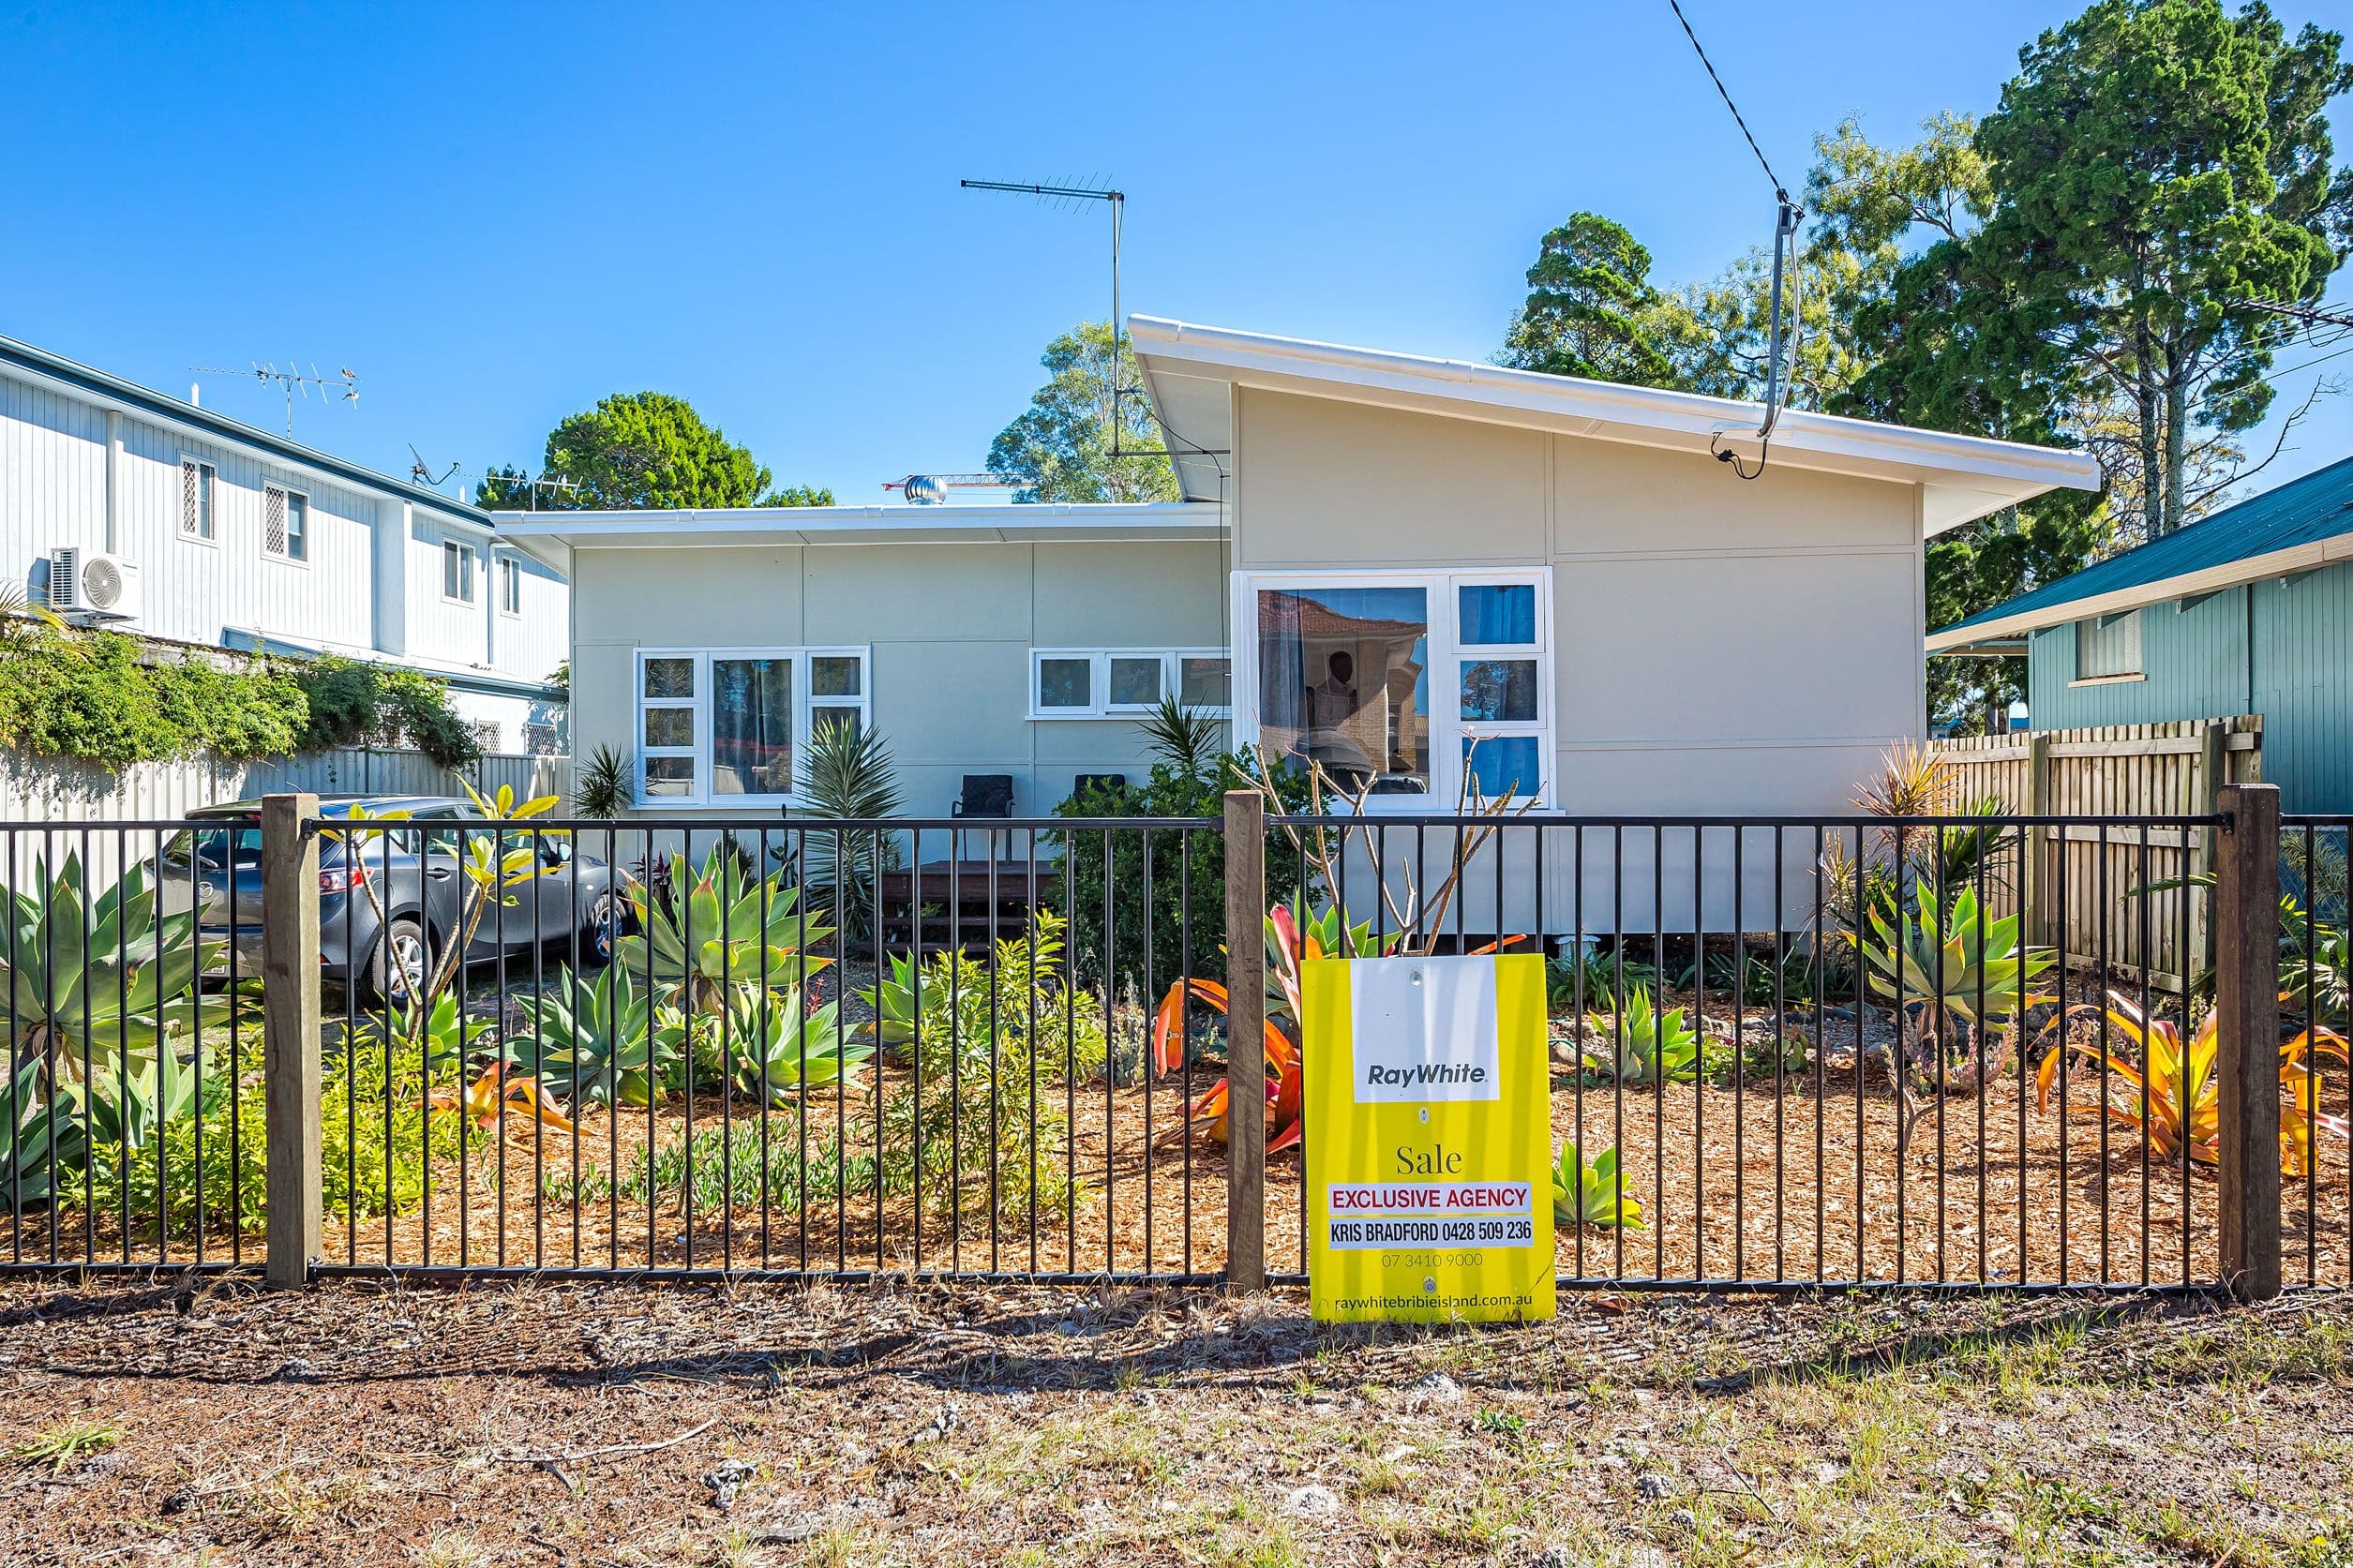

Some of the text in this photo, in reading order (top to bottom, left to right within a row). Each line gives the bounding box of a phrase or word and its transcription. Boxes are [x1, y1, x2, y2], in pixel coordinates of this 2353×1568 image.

[1396, 1143, 1462, 1175] Sale
[1332, 1188, 1528, 1209] EXCLUSIVE AGENCY
[1331, 1220, 1532, 1243] KRIS BRADFORD 0428 509 236
[1381, 1253, 1483, 1268] 07 3410 9000
[1335, 1293, 1533, 1311] raywhitebribieisland.com.au
